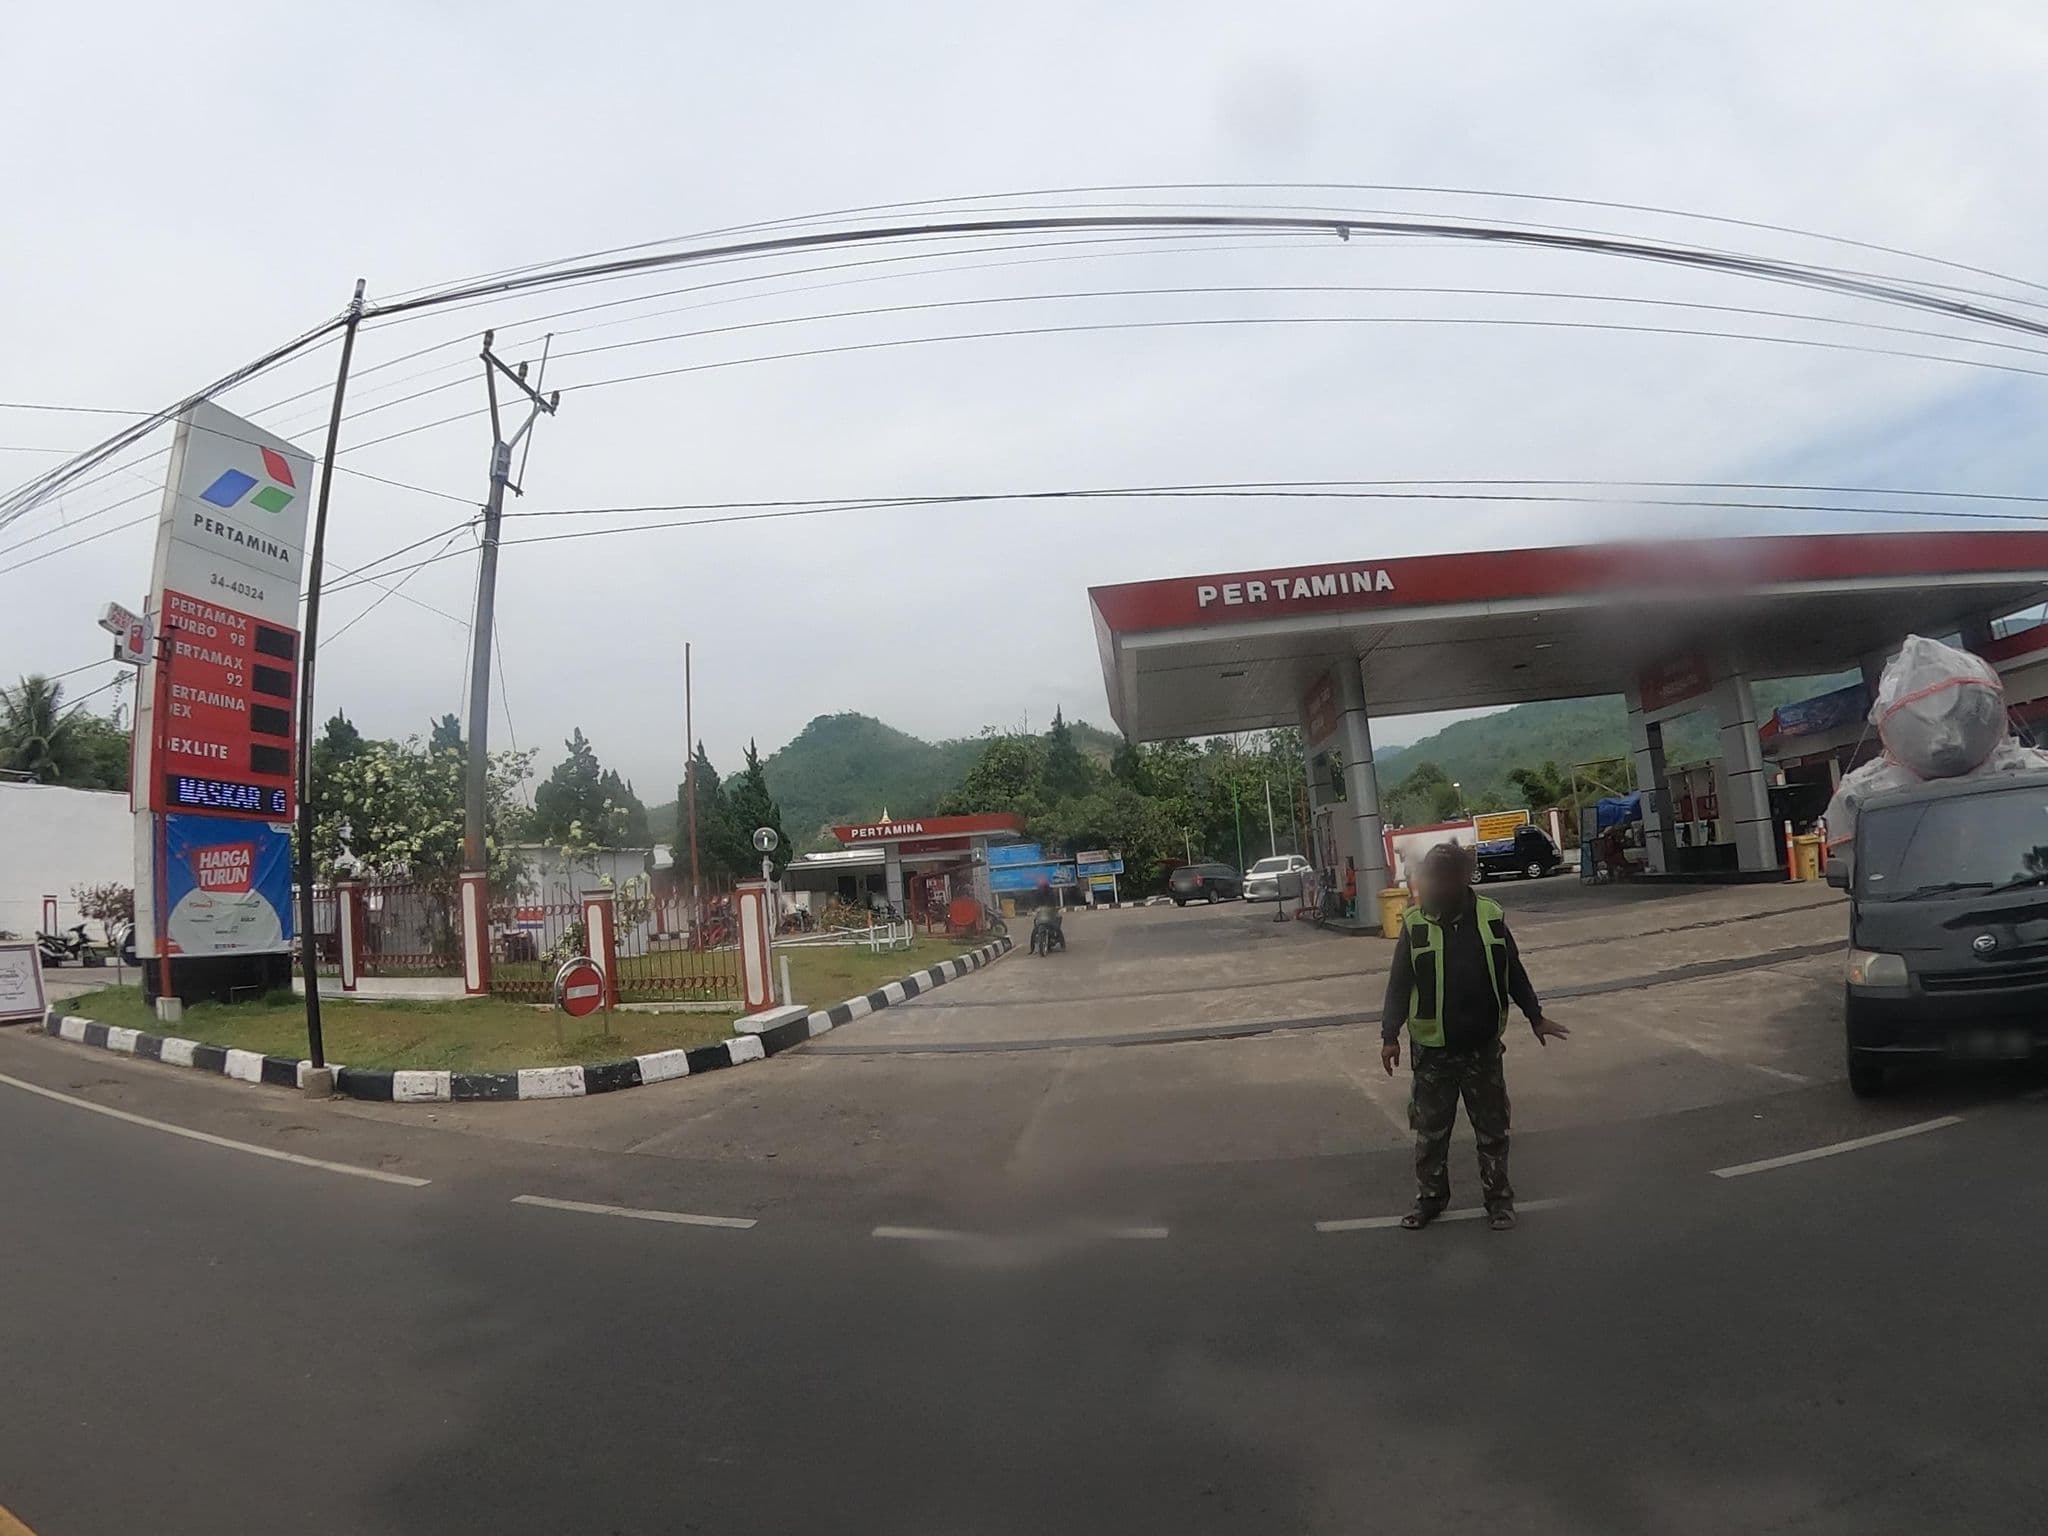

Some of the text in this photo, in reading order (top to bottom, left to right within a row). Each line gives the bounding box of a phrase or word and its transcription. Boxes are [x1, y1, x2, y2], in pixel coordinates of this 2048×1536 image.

[193, 513, 290, 563] PERTAMINA
[210, 573, 264, 601] 34-40324
[1197, 569, 1395, 608] PERTAMINA
[171, 597, 247, 630] PERTAMAX
[170, 614, 246, 647] TURBO 98
[175, 641, 244, 671] ERTAMAX
[226, 672, 243, 687] 92
[168, 702, 192, 719] EX
[172, 684, 246, 711] ERTAMINA
[851, 822, 924, 838] PERTAMINA
[199, 848, 250, 868] HARGA
[199, 867, 248, 887] TURUN
